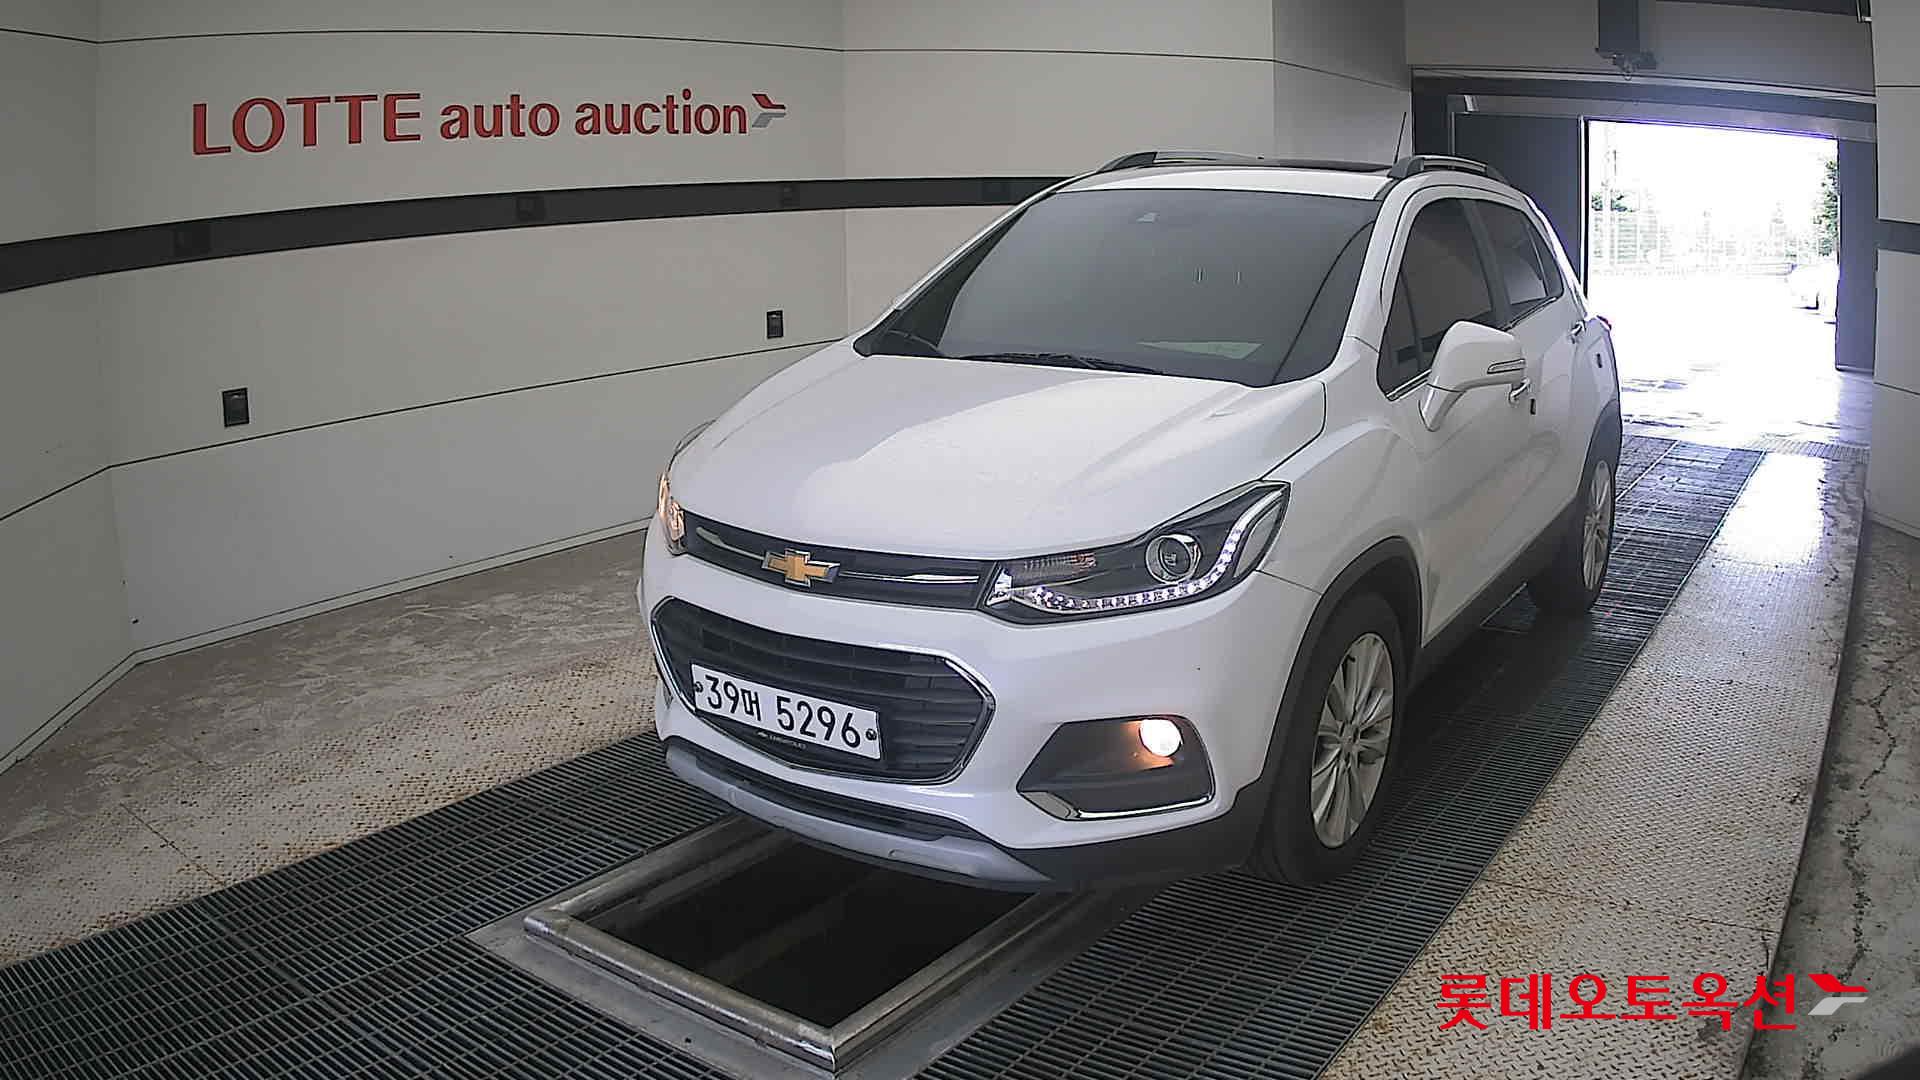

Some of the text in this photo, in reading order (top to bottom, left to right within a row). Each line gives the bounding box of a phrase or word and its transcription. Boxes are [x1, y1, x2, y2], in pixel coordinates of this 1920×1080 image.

[192, 88, 748, 156] LOTTE auto auction
[704, 674, 861, 748] 39머 5296
